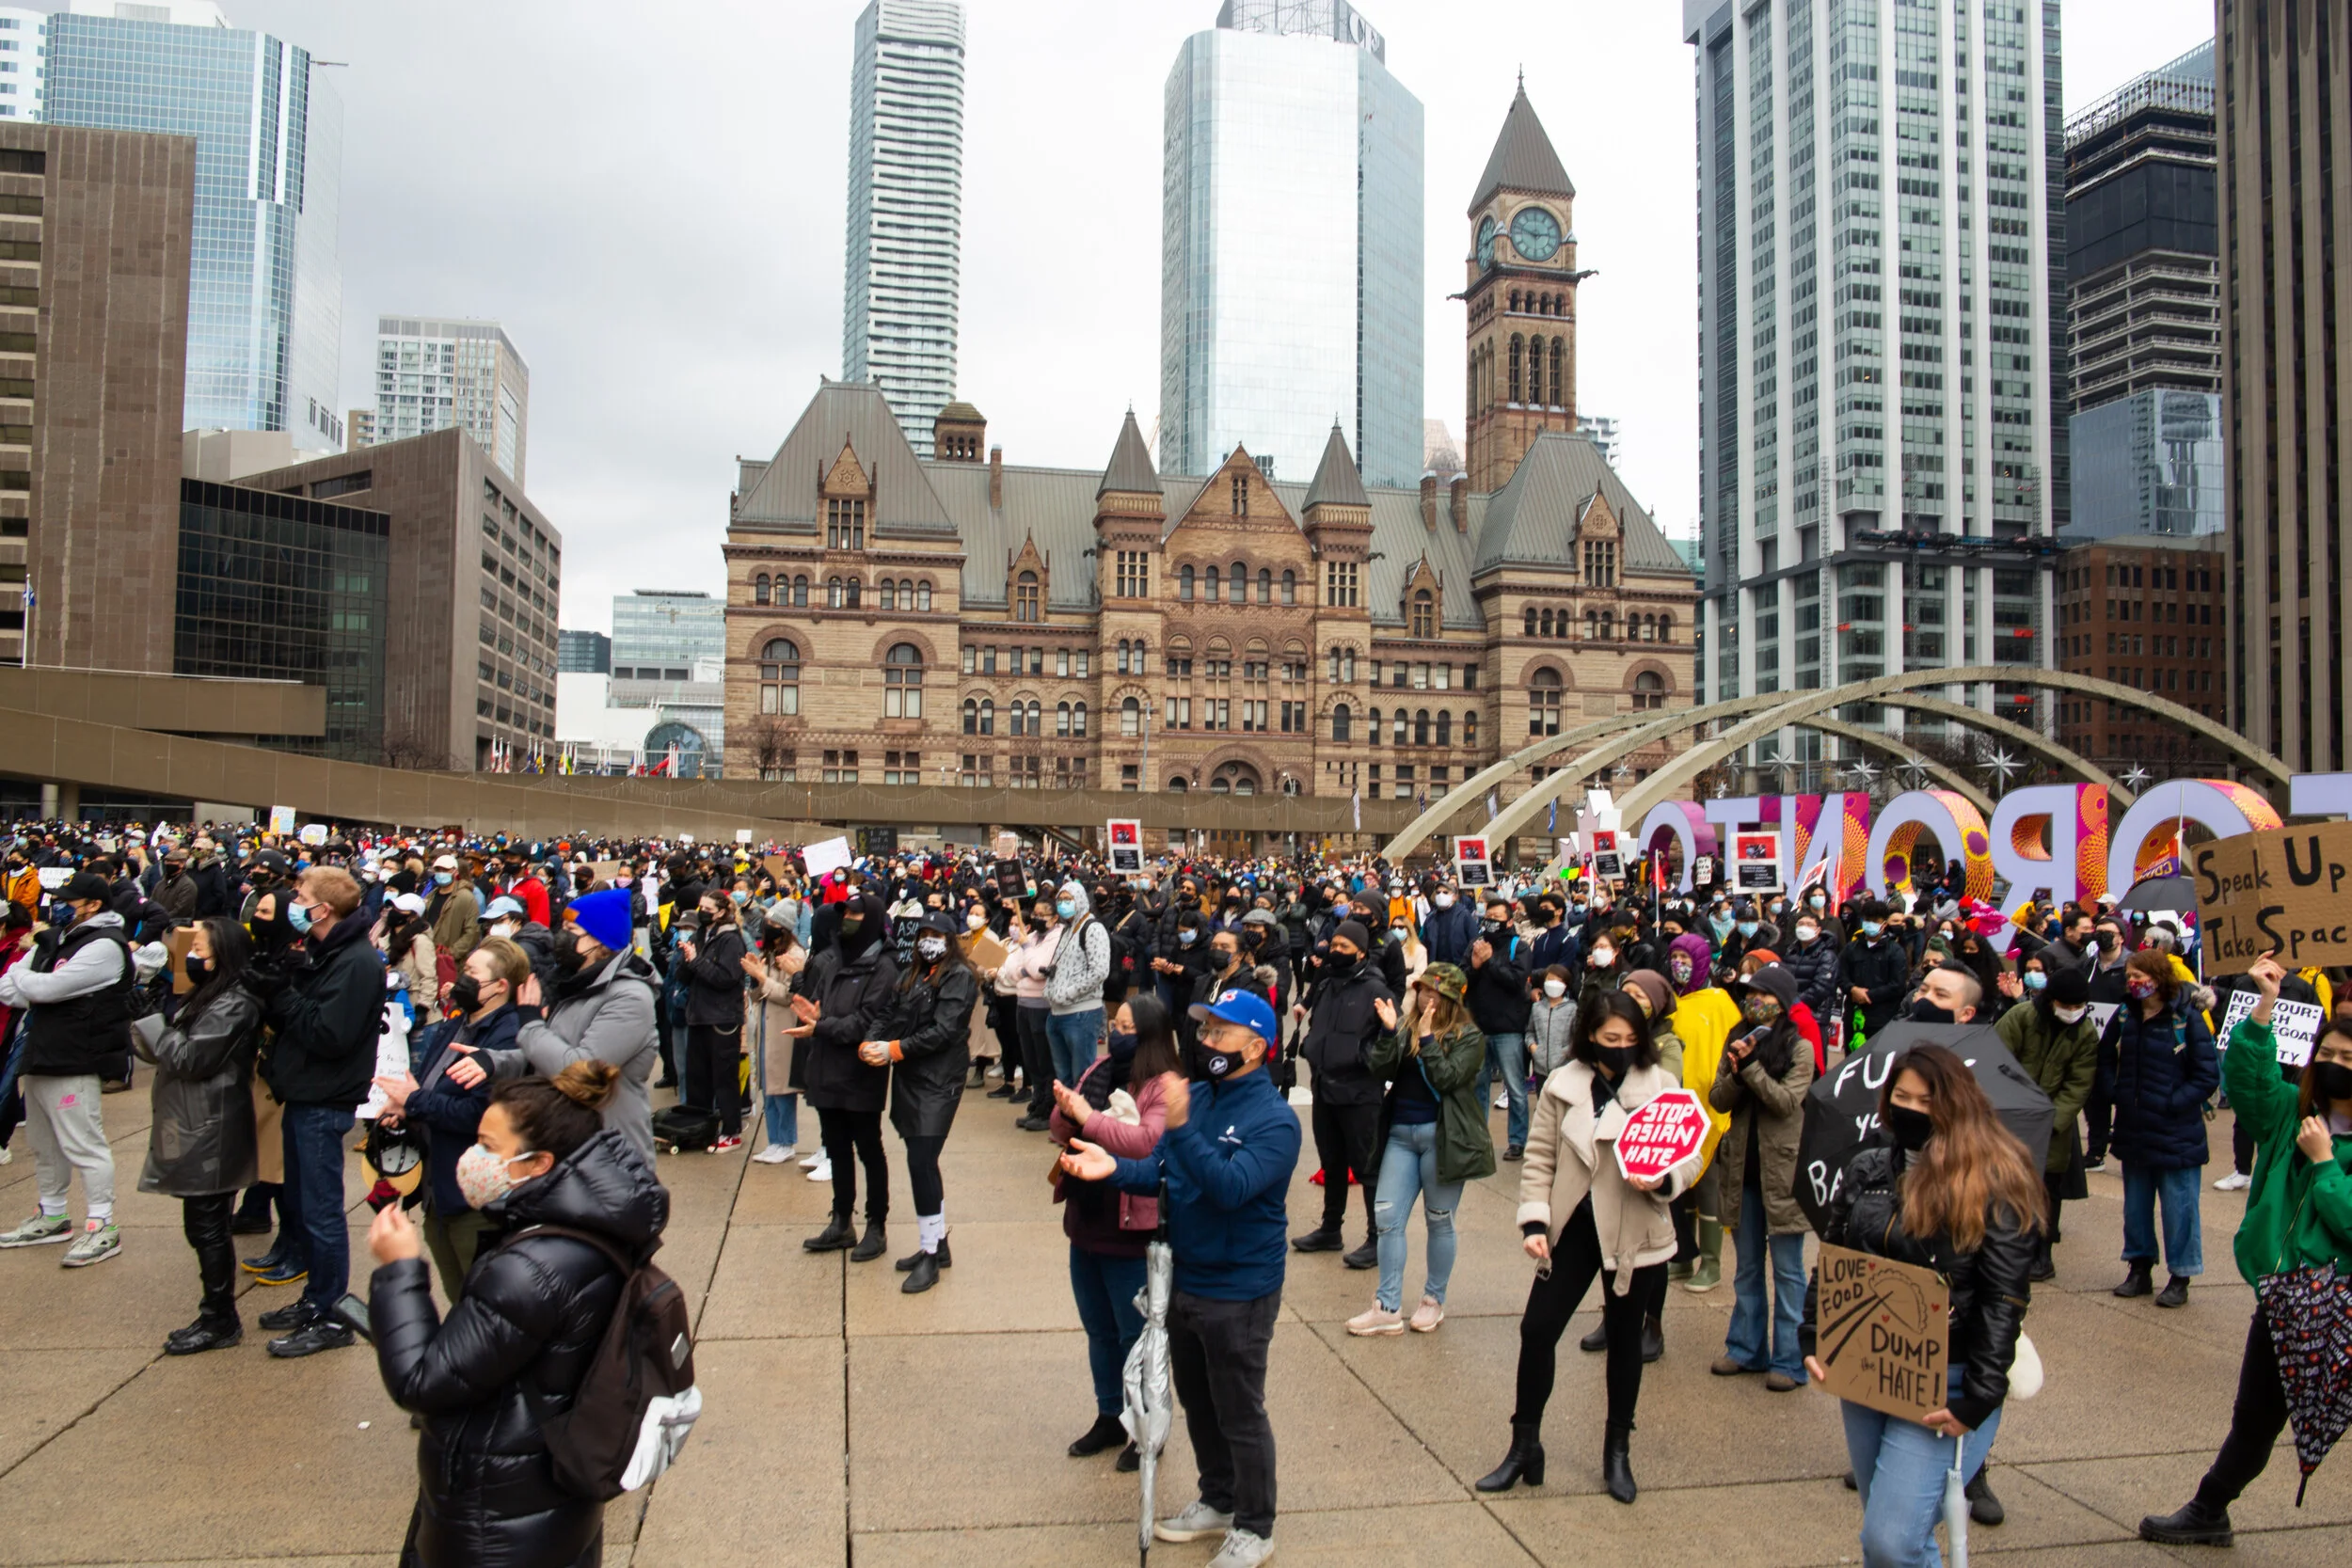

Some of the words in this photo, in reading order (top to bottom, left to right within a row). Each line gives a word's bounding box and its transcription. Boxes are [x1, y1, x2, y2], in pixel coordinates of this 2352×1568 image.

[2197, 848, 2272, 906] Speak
[2283, 835, 2346, 894] Up
[2203, 915, 2255, 962] Take
[1642, 1102, 1696, 1124] STOP
[1624, 1122, 1696, 1147] ASIAN
[1624, 1145, 1676, 1166] HATE
[1823, 1256, 1867, 1284] LOVE
[1821, 1282, 1864, 1318] FOOD
[1870, 1323, 1940, 1370] DUMP
